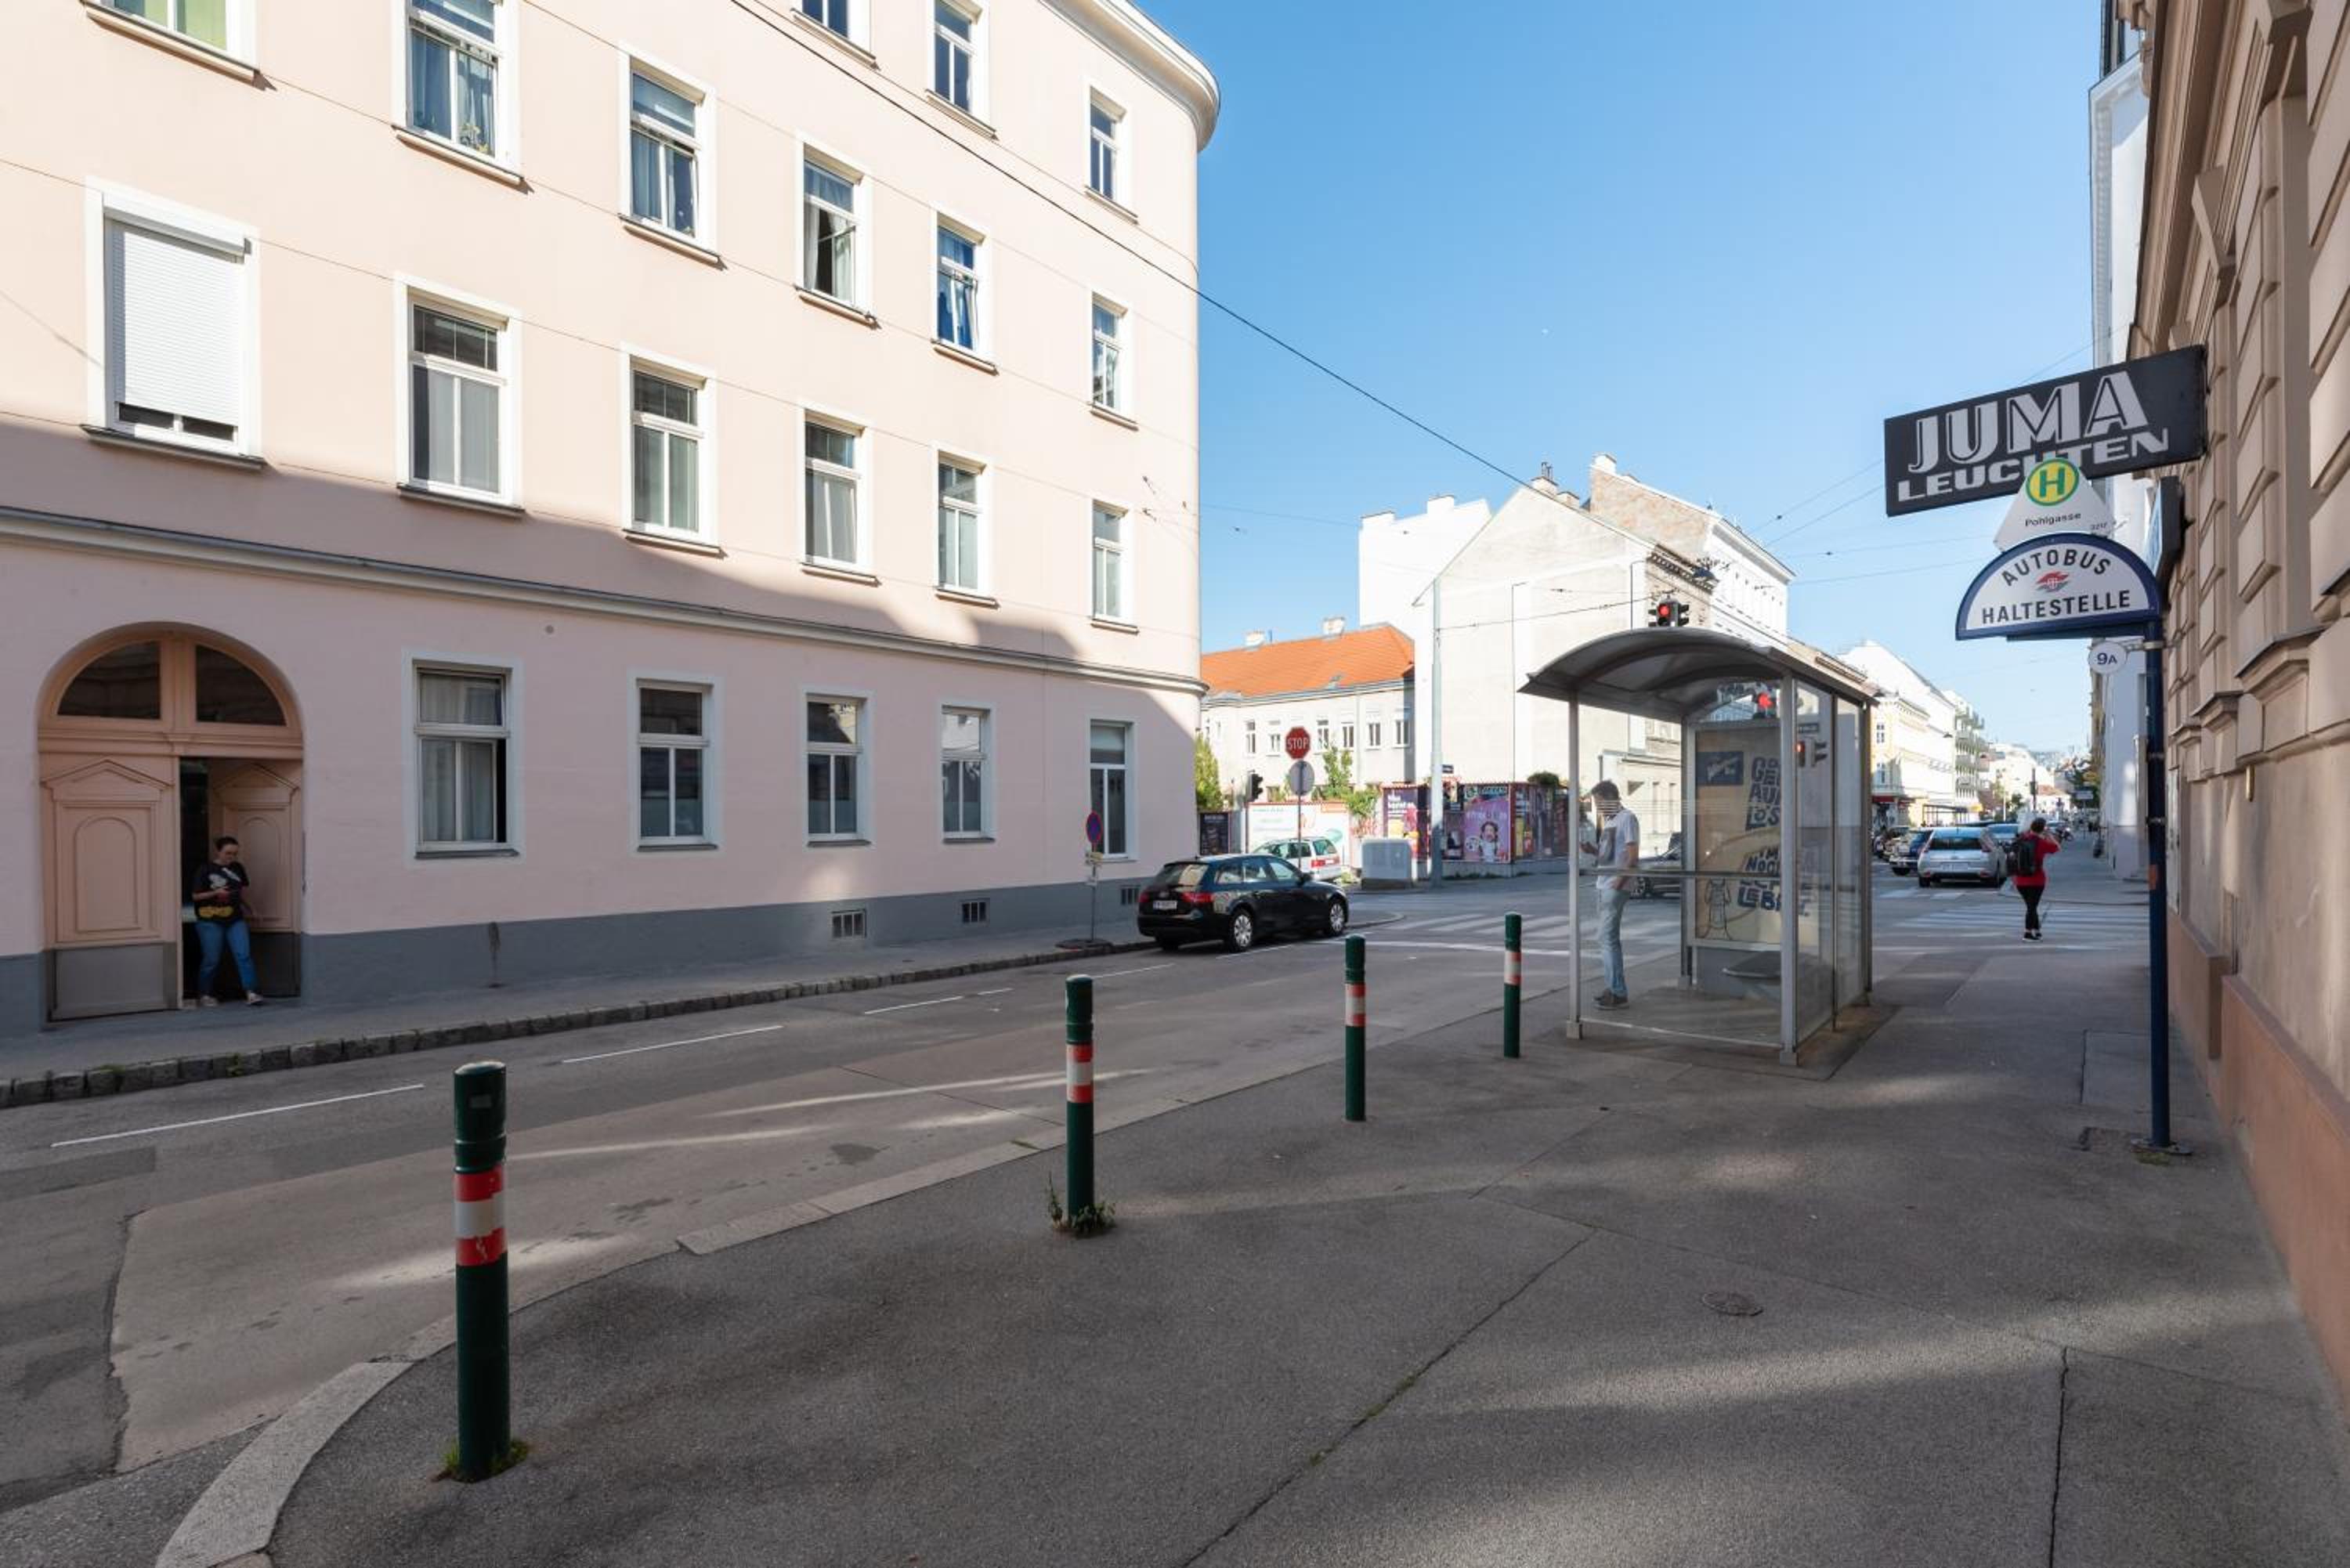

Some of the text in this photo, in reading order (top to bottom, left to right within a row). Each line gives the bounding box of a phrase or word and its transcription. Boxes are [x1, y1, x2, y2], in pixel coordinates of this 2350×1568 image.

[1907, 370, 2149, 473] JUMA
[2039, 467, 2066, 498] H
[2025, 512, 2081, 527] Pohlgasse
[2001, 549, 2111, 586] AUTOBUS
[1982, 590, 2130, 624] HALTESTELLE
[2097, 652, 2118, 665] 9A
[1288, 737, 1309, 751] STOP
